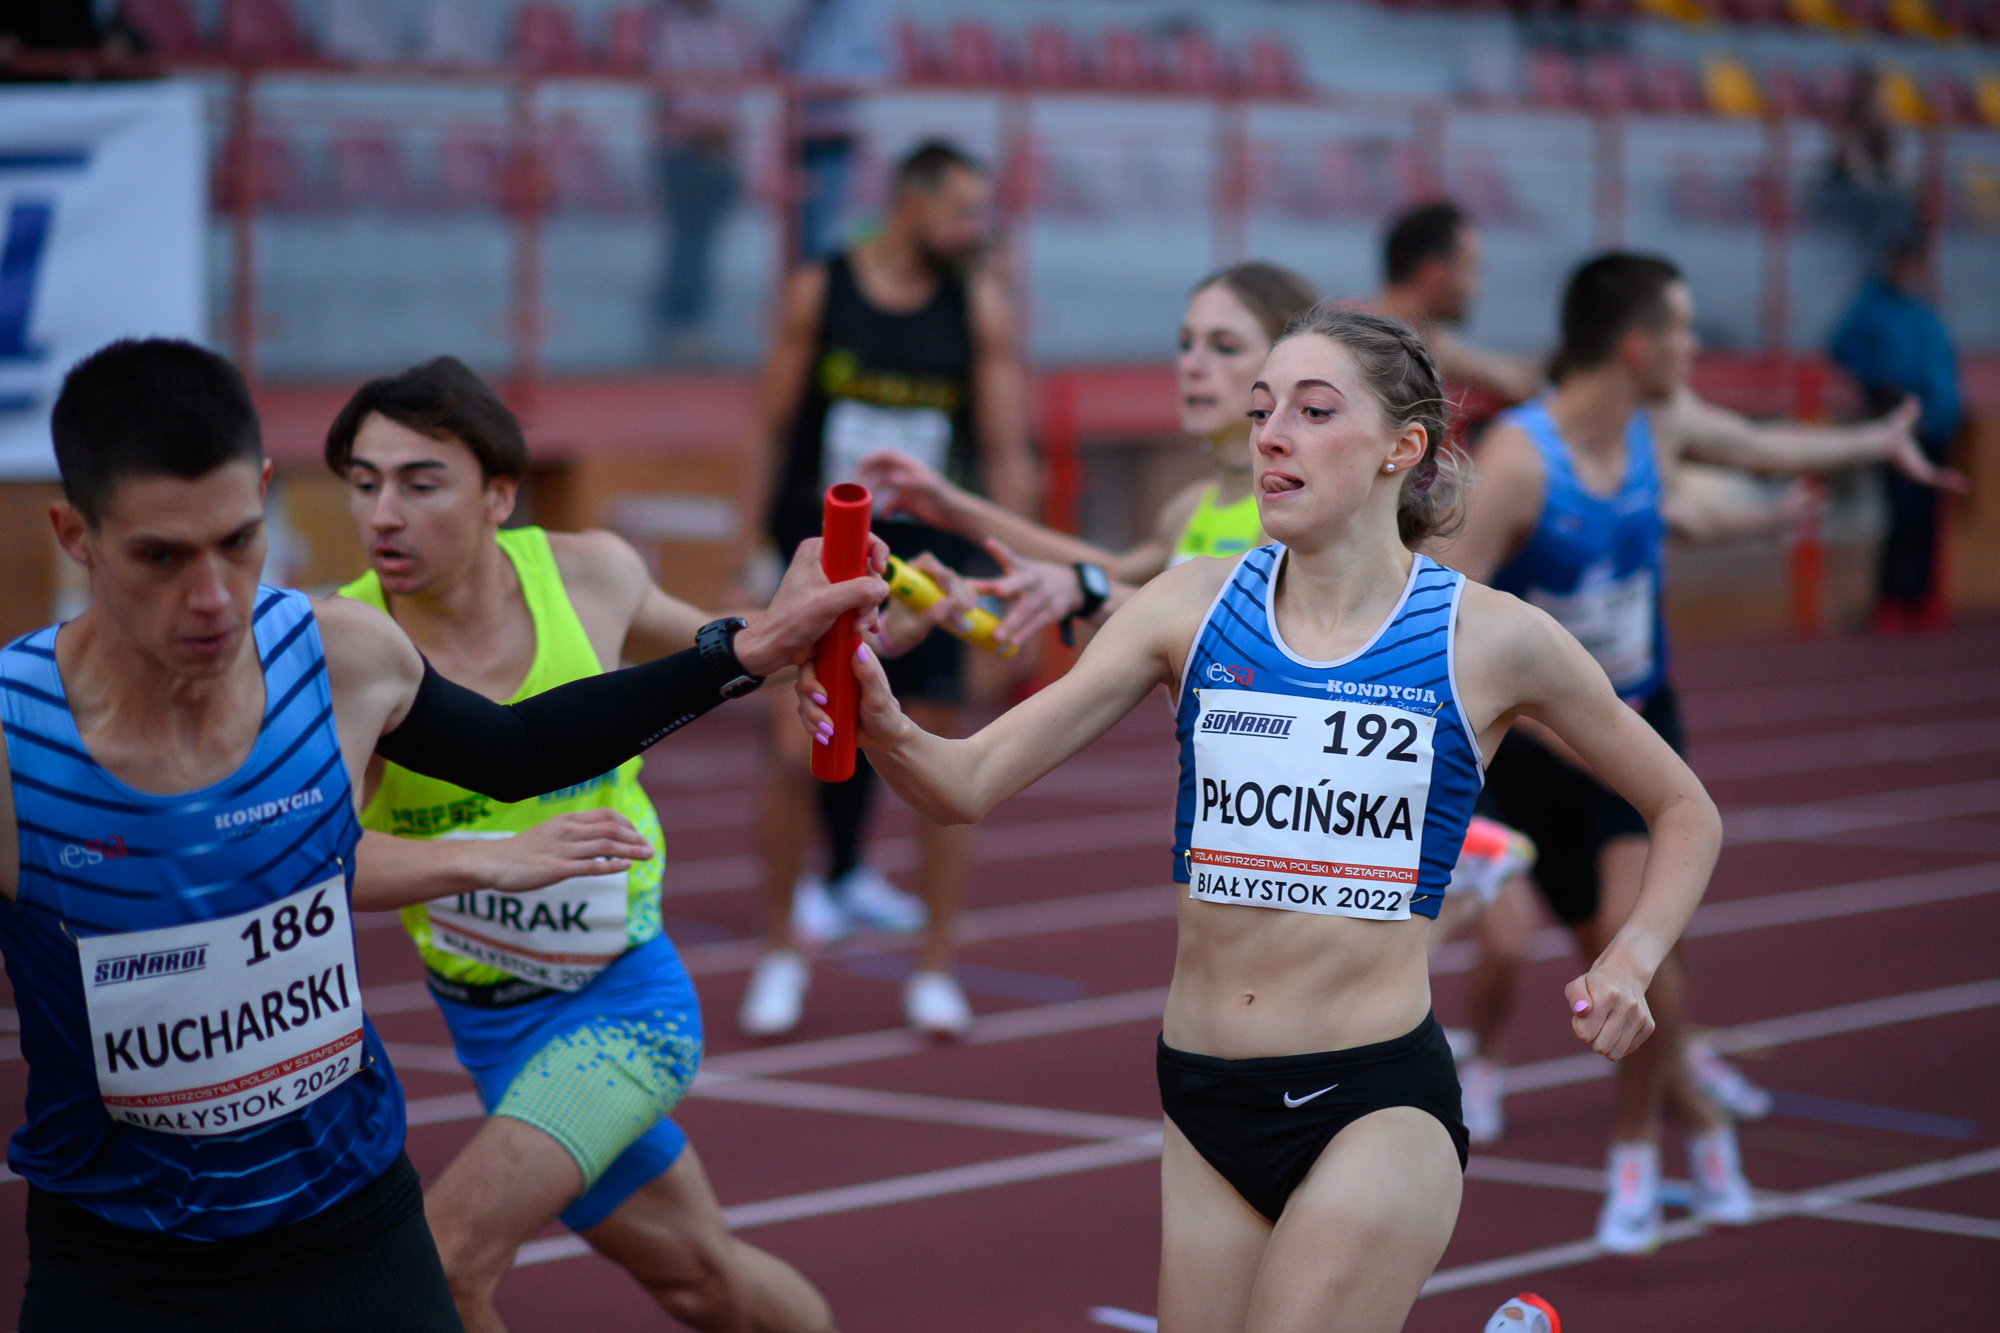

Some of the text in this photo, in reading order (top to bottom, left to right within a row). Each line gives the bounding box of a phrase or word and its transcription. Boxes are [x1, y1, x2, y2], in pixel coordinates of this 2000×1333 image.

[1326, 679, 1437, 704] KONDYCJA
[1201, 710, 1295, 738] SONAROL
[1322, 710, 1418, 763] 192
[1202, 777, 1414, 842] PŁOCIŃSKA
[1195, 851, 1413, 881] PZLA MISTRZOSTWA POLSKI W SZTAFETACH
[1197, 872, 1403, 912] BIAŁYSTOK 2022
[240, 888, 335, 967] 186
[94, 947, 208, 984] SONAROL
[104, 963, 351, 1074] KUCHARSKI
[124, 1056, 350, 1129] BIAŁYSTOK 2022
[146, 1083, 238, 1106] MISTRZOSTWA
[240, 1068, 280, 1088] POLSKI
[281, 1062, 293, 1072] W
[295, 1033, 359, 1068] SZTAFETACH
